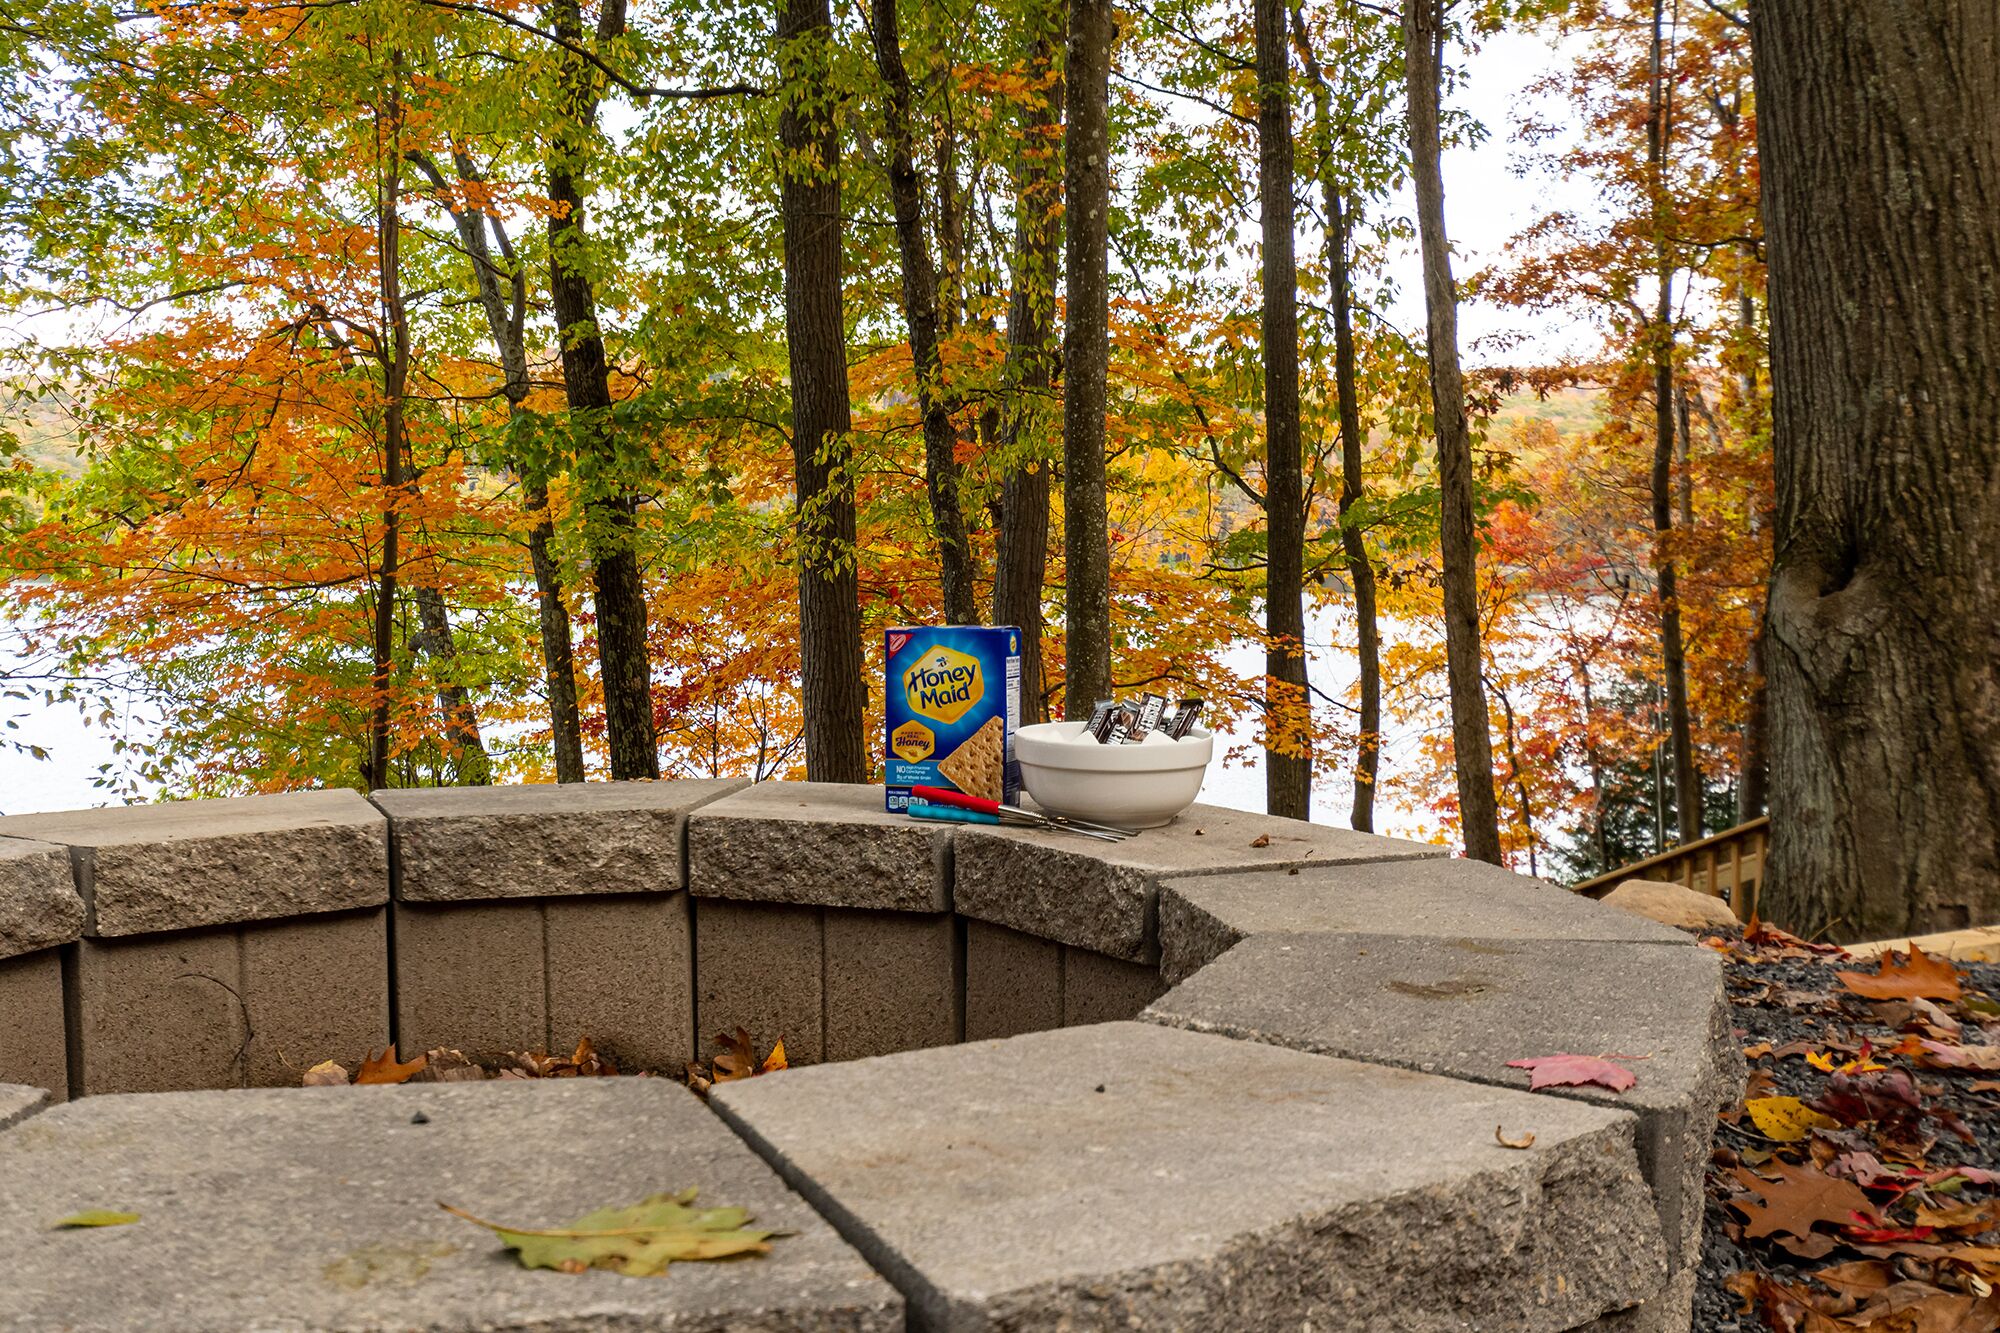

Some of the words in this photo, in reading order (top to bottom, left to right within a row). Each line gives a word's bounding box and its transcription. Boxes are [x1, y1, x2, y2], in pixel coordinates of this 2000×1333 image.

[908, 664, 976, 693] Honey
[920, 681, 970, 709] Maid
[896, 737, 931, 751] Honey
[896, 766, 906, 774] NO
